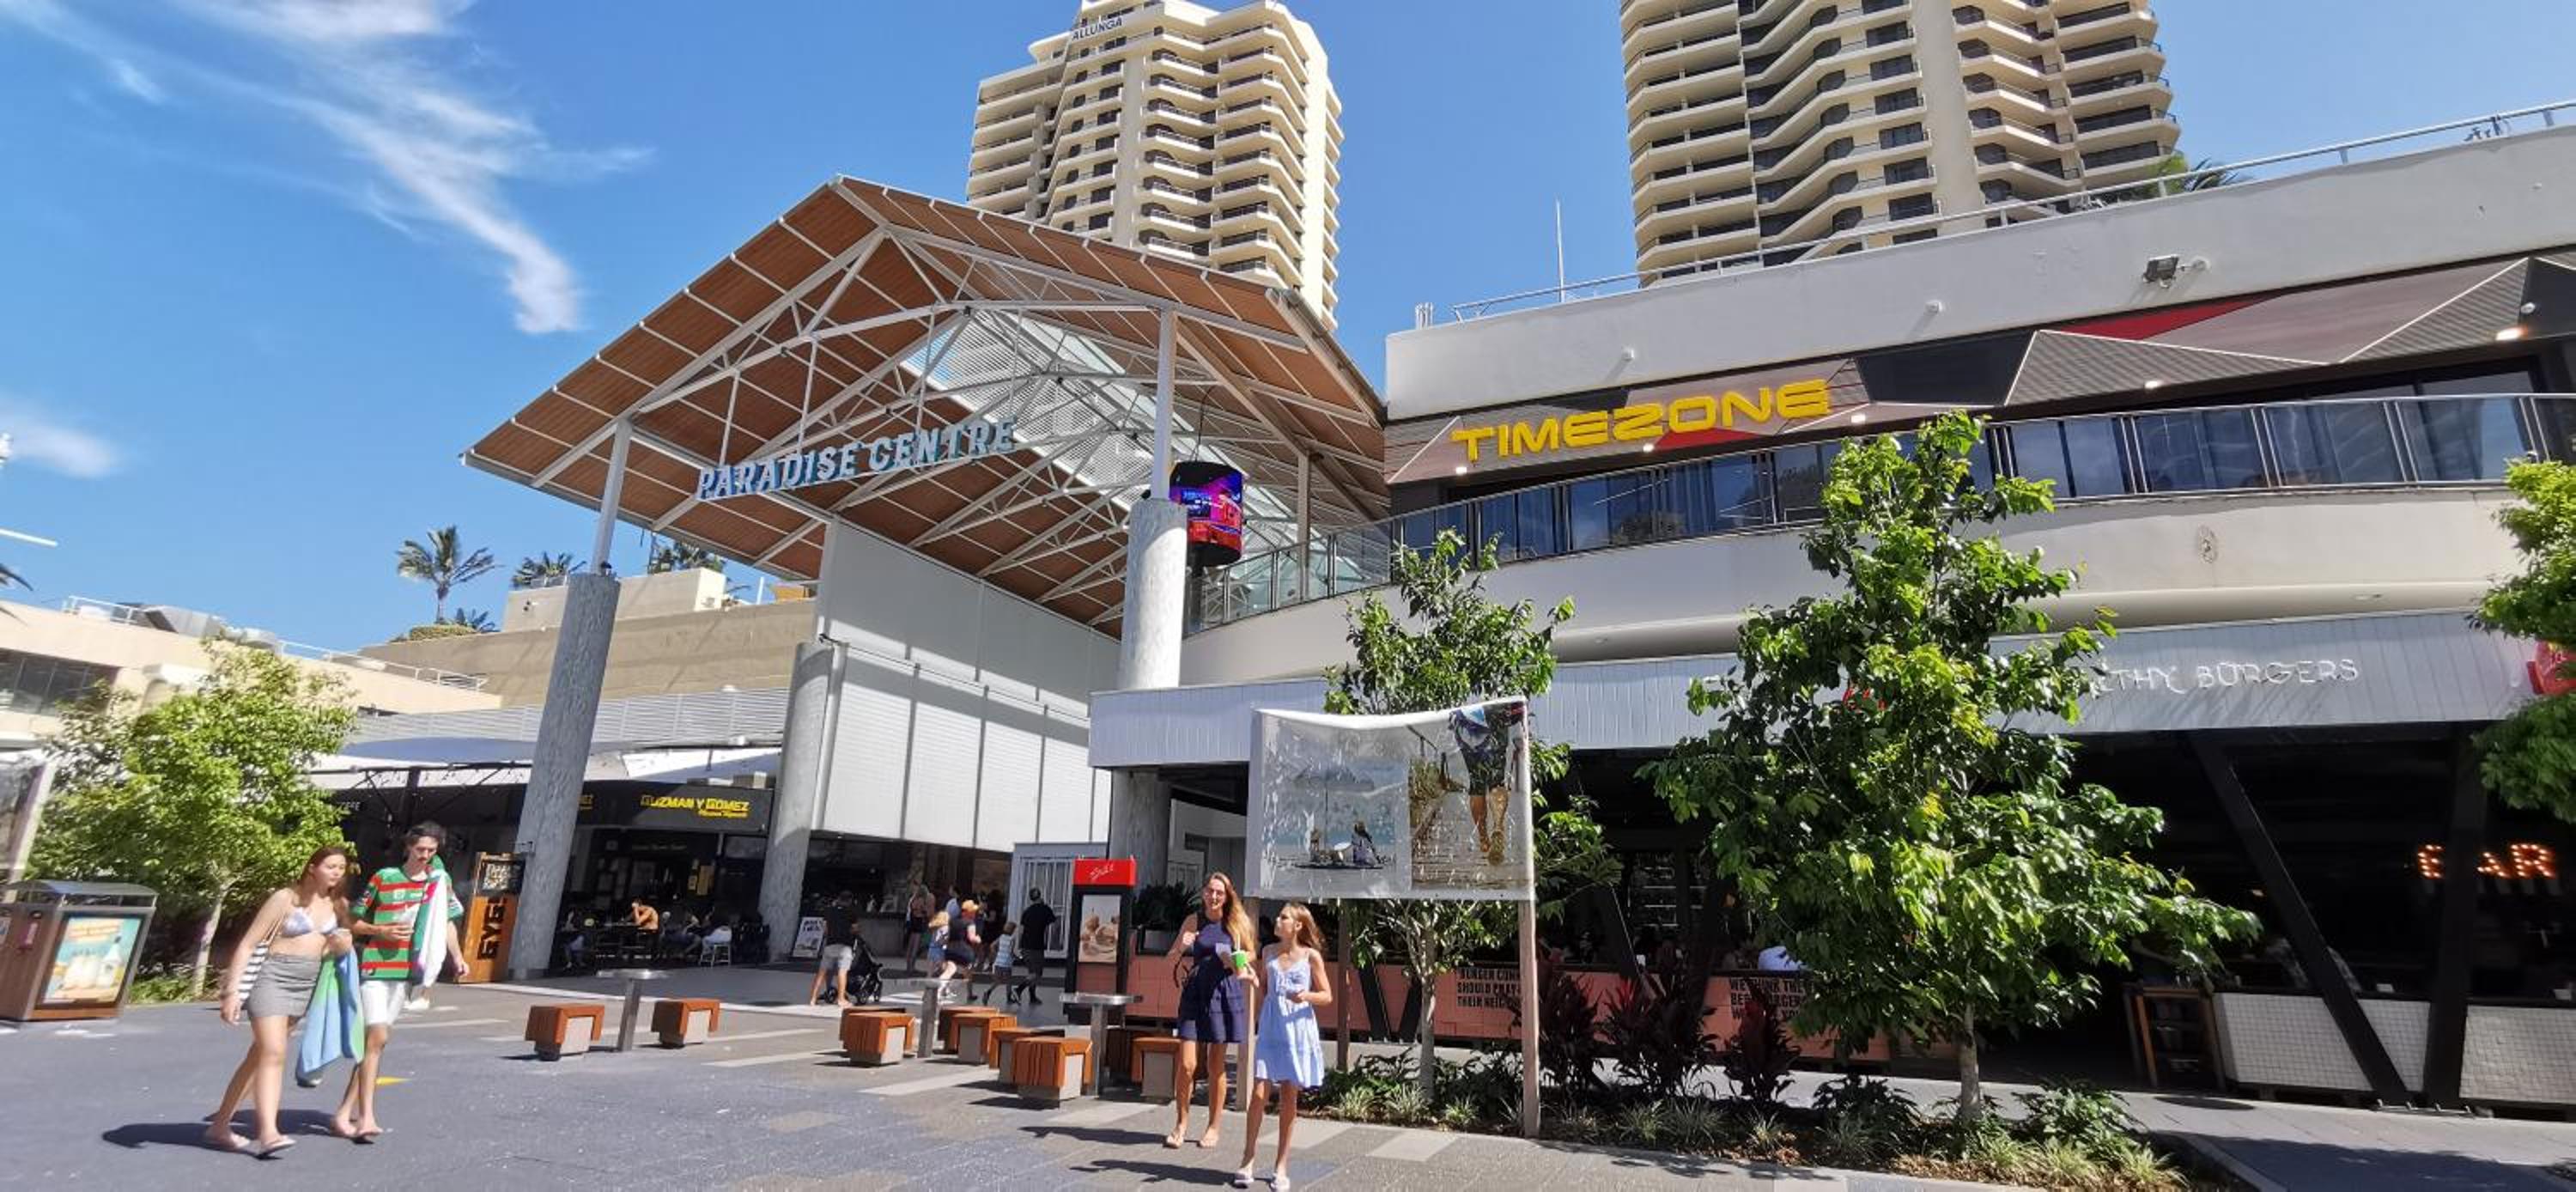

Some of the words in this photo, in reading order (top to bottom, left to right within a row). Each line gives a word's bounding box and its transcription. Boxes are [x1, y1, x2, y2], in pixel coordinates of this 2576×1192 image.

[1072, 16, 1123, 40] ALLUNGA
[1450, 379, 1830, 463] TIMEZONE
[696, 441, 859, 501] PARADISE
[869, 417, 1016, 473] CENTRE
[2197, 658, 2359, 689] BURGERS
[640, 794, 694, 809] GUZMAN
[696, 797, 703, 809] Y
[706, 797, 750, 812] GOMEZ
[1457, 982, 1492, 994] SHOULD
